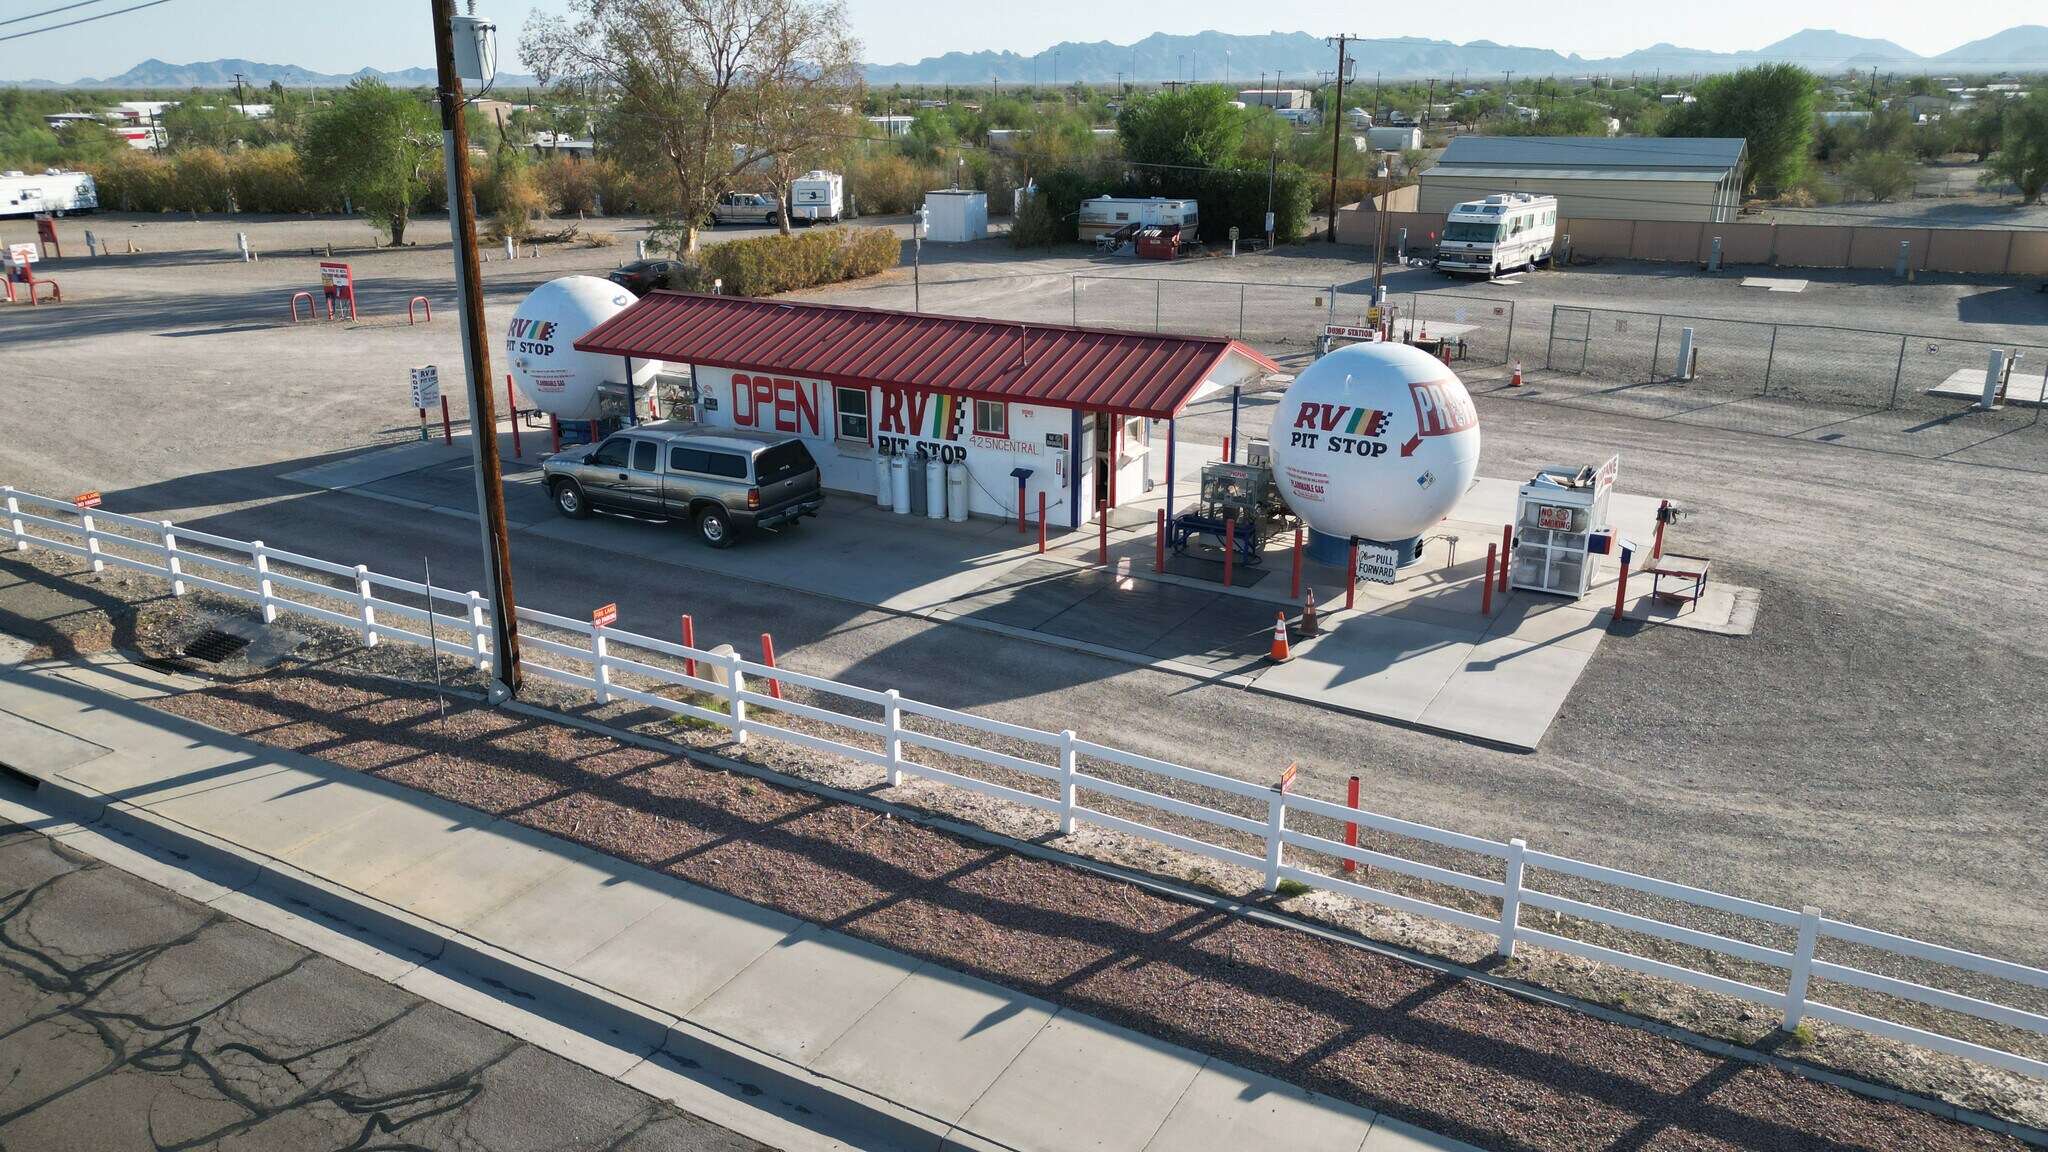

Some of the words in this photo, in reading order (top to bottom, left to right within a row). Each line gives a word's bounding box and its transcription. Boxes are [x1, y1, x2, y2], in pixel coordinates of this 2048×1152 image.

[508, 318, 532, 338] RV
[1327, 327, 1345, 335] DUMP
[1347, 328, 1373, 338] STATION
[520, 341, 554, 356] STOP
[411, 369, 420, 407] PROPANE
[732, 373, 819, 436] OPEN
[879, 385, 930, 436] RV
[1294, 402, 1351, 432] RV
[878, 435, 909, 456] PIT
[915, 440, 967, 465] STOP
[1291, 432, 1319, 449] PIT
[1328, 436, 1388, 458] STOP
[1291, 479, 1314, 493] FLAMMABLE
[1315, 484, 1324, 494] GAS
[1541, 508, 1552, 517] NO
[1540, 518, 1571, 530] SMOKING
[1375, 554, 1393, 566] PULL
[1359, 563, 1394, 578] FORWARD
